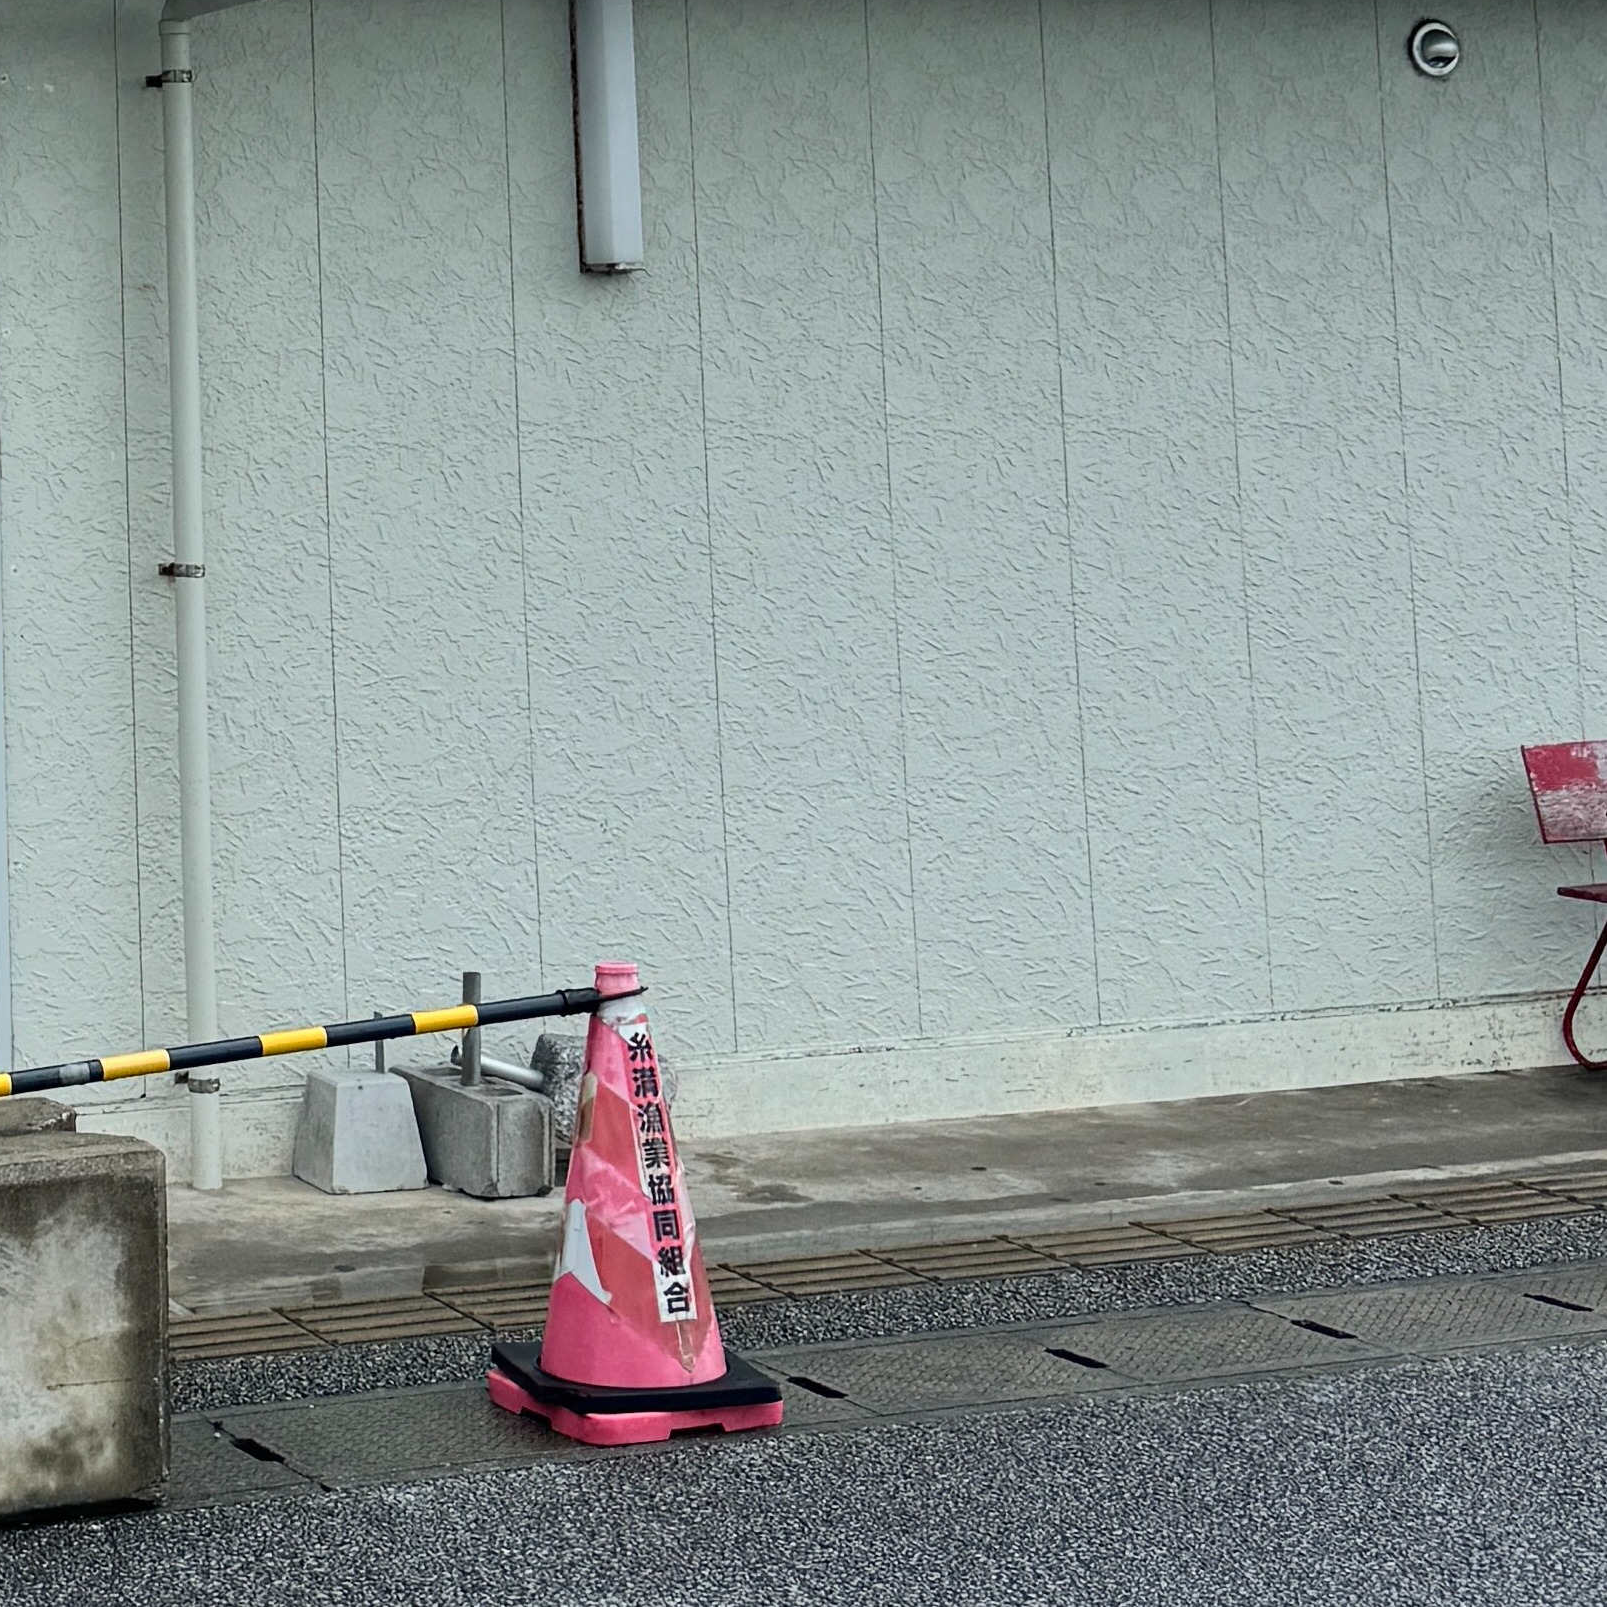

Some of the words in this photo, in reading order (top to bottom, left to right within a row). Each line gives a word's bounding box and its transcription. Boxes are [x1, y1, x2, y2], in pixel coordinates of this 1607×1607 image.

[627, 1031, 691, 1314] 糸満漁業協同組合
